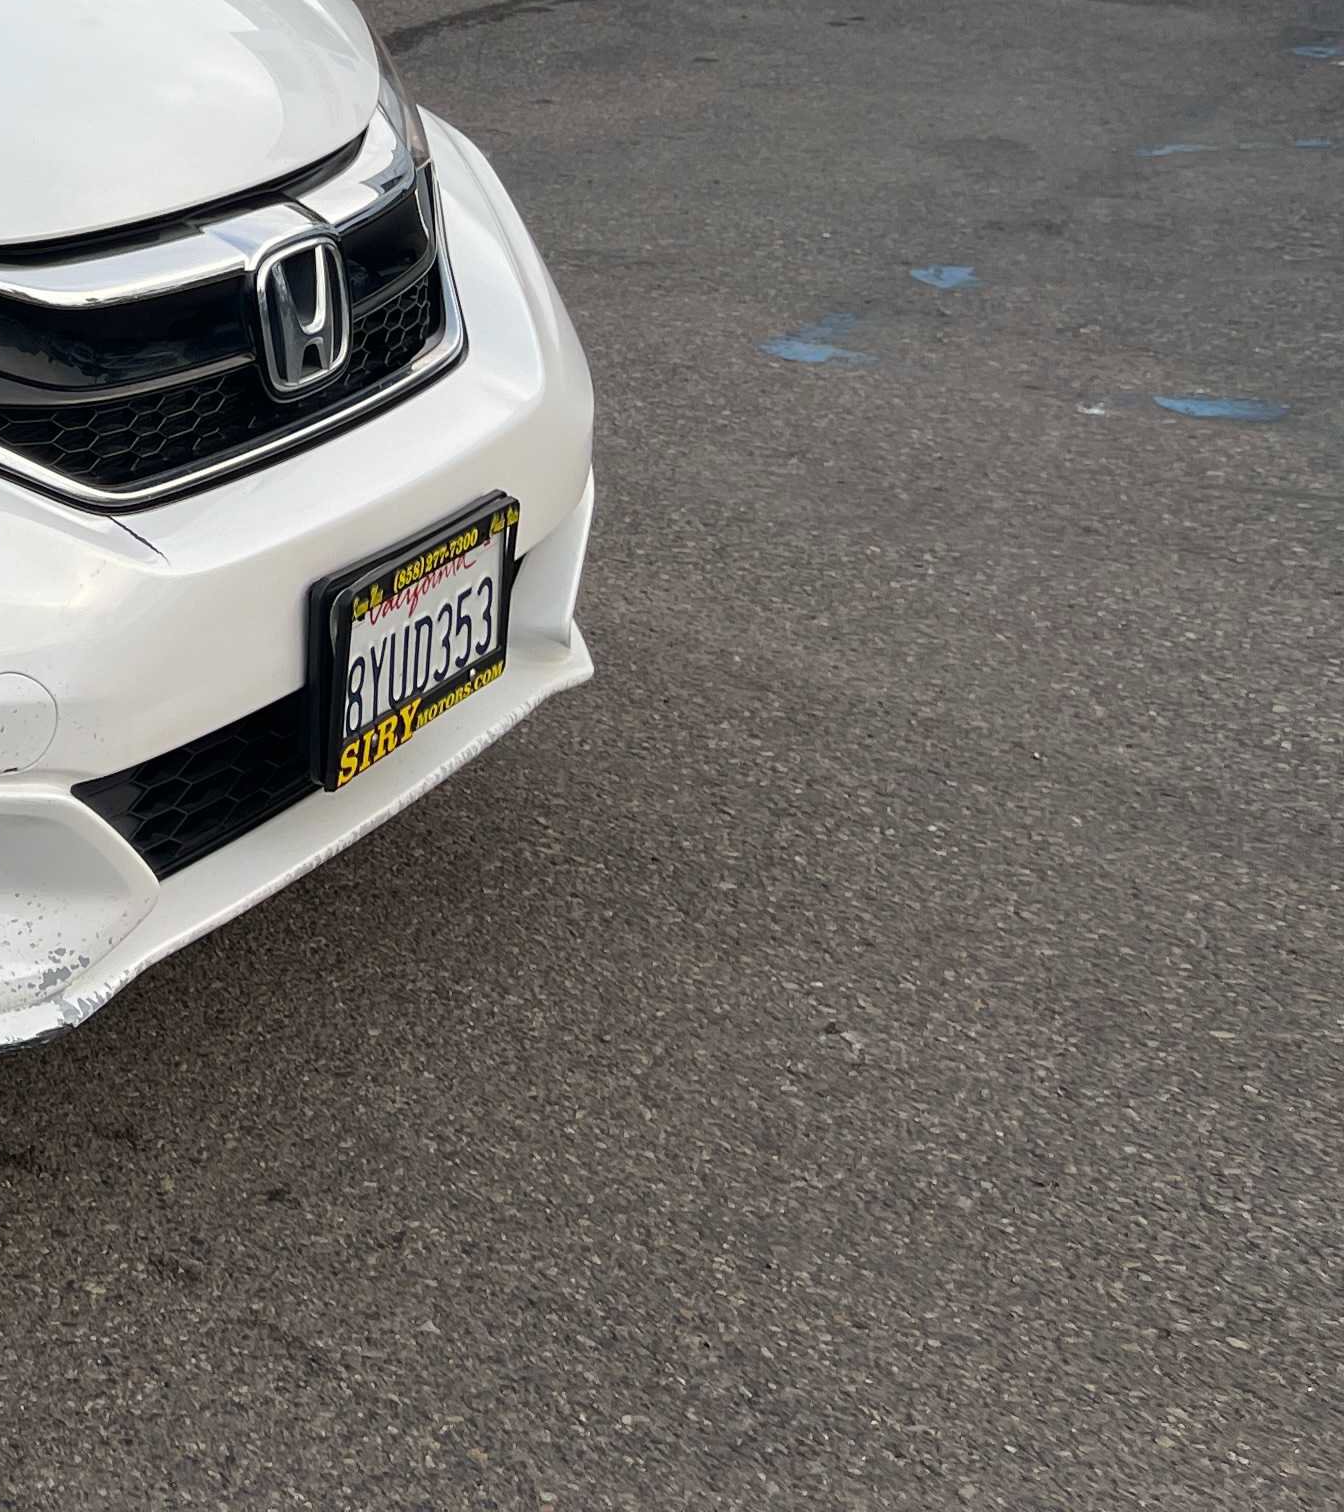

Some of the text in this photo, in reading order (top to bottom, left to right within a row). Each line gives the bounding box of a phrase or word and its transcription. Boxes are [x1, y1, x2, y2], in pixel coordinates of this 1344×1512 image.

[368, 554, 477, 625] California
[346, 577, 493, 736] 8YUD353
[337, 663, 505, 786] SIRY MOTORS.COM
